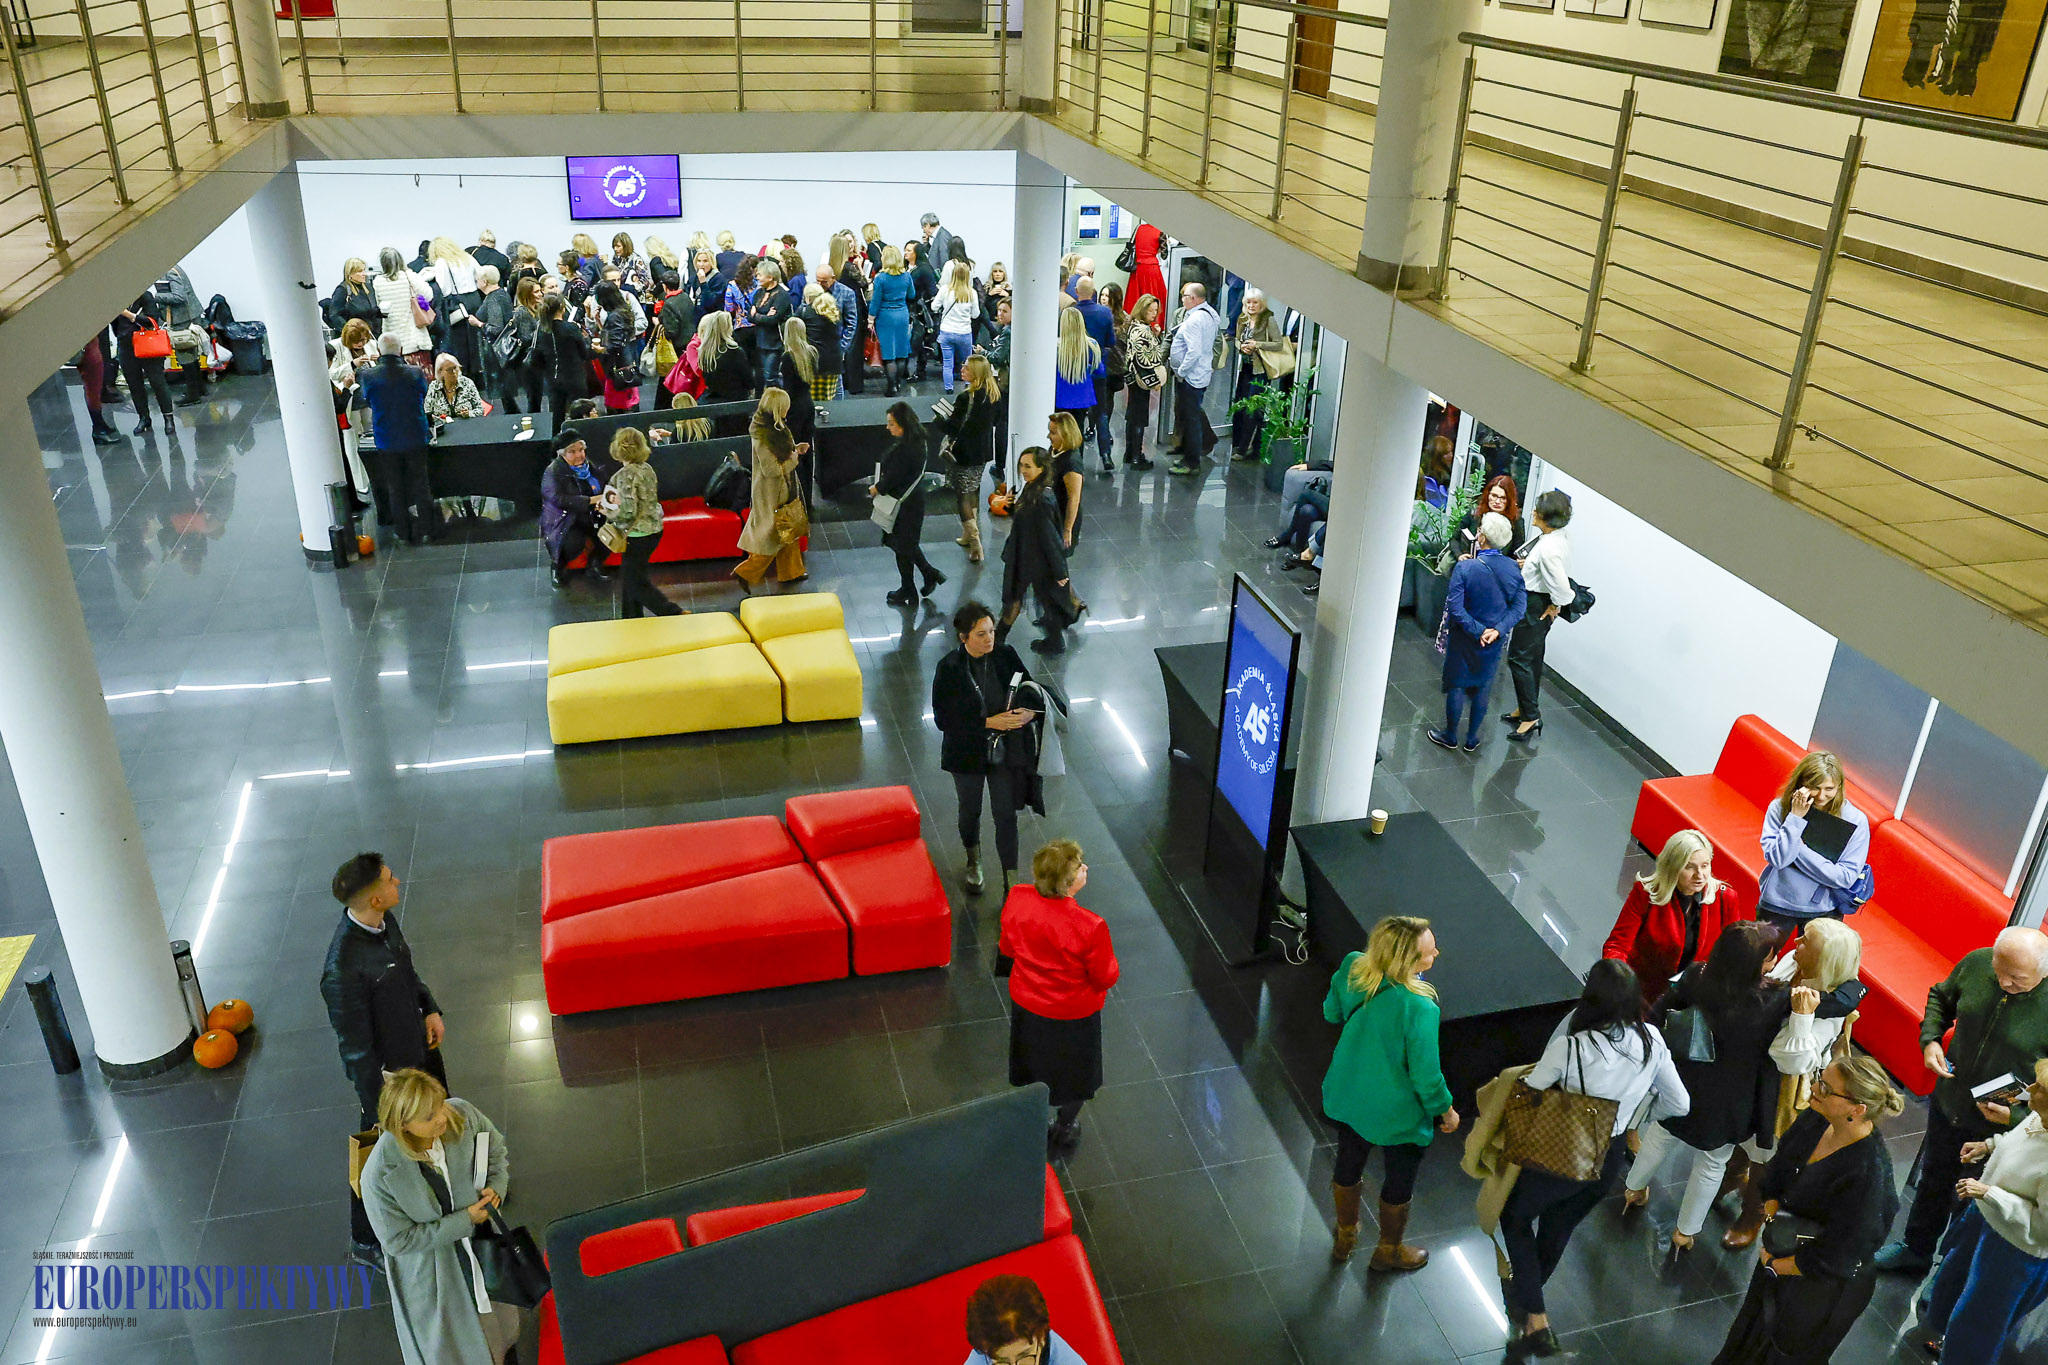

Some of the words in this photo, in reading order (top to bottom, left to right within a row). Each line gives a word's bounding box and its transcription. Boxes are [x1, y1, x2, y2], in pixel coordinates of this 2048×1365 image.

[1236, 666, 1265, 699] AKADEMIA
[1235, 704, 1251, 762] ACADEMY
[1250, 759, 1258, 772] OF
[1258, 750, 1276, 774] SILESIA
